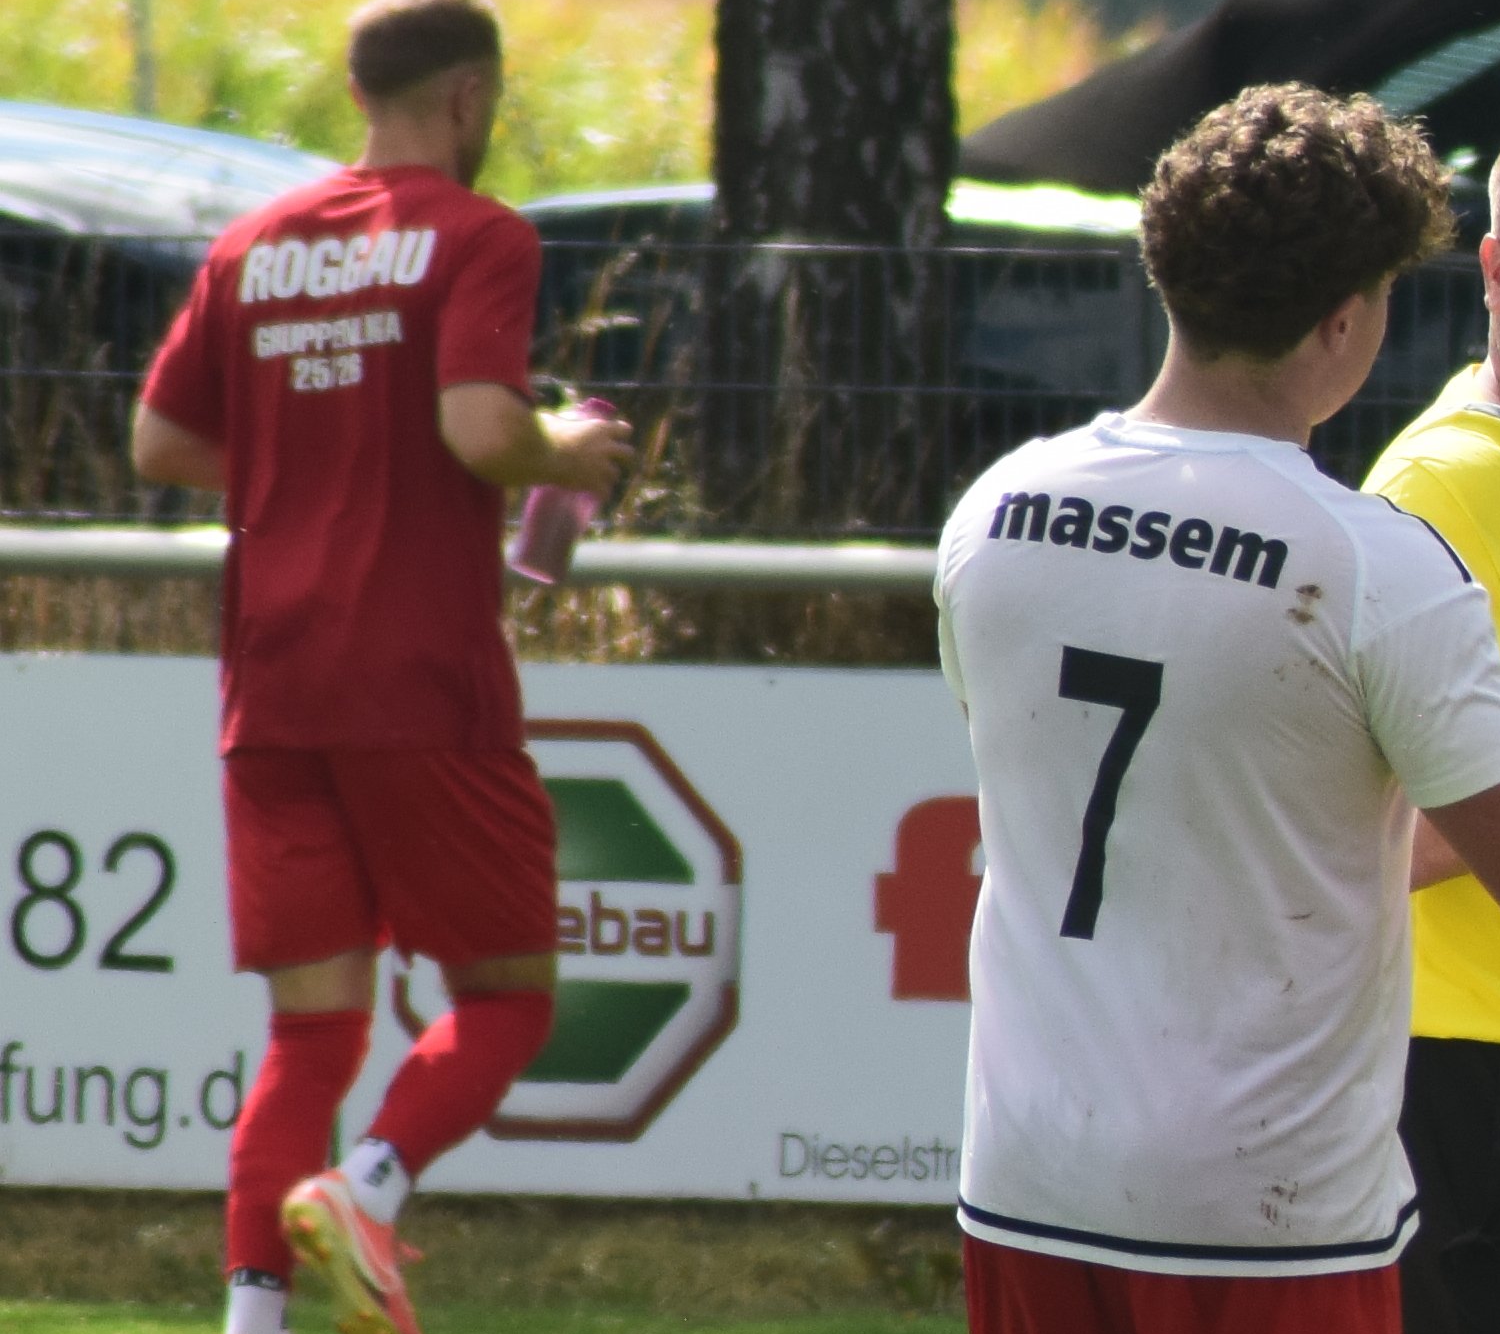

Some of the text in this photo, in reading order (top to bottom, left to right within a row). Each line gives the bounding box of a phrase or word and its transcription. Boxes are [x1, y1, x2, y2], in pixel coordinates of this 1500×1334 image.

[240, 228, 437, 303] ROGGAU
[987, 491, 1288, 589] massem
[1059, 645, 1164, 939] 7
[10, 829, 175, 973] 82
[557, 891, 715, 956] ebau
[0, 1040, 245, 1150] fung.d
[780, 1132, 962, 1181] Dieselstr
